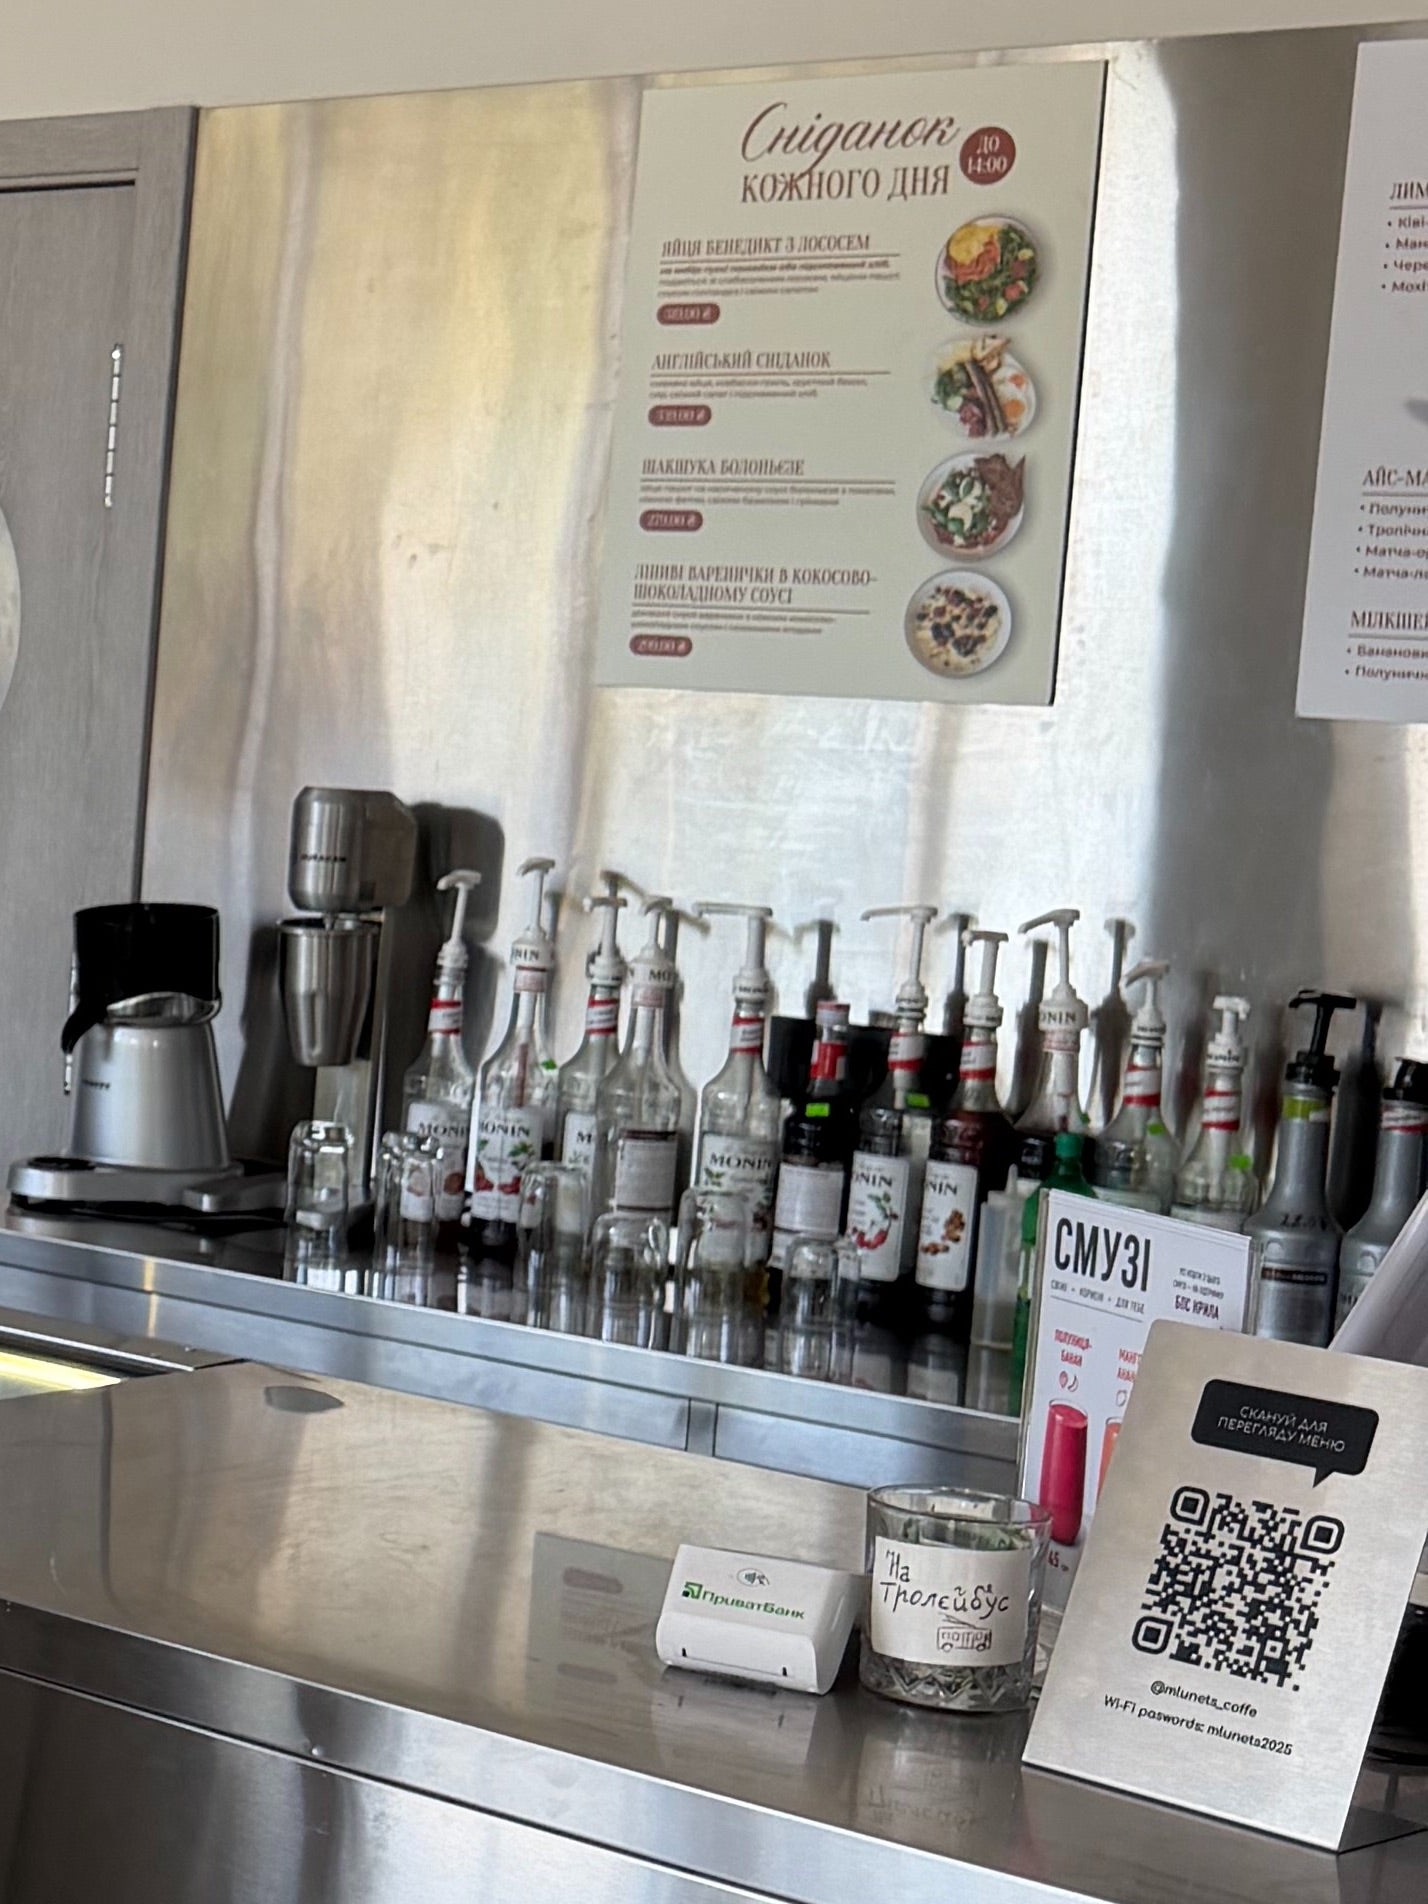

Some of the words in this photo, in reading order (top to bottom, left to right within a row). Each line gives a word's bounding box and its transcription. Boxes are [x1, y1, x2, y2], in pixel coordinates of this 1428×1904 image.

[741, 101, 960, 176] Сніданок
[976, 134, 1000, 154] ДО
[742, 167, 880, 203] КОЖНОГО
[888, 165, 950, 201] ДНЯ
[1390, 181, 1428, 200] ЛИМ
[756, 351, 832, 370] СНІДАНОК
[1351, 610, 1428, 631] МІЛКШЕ
[1040, 1011, 1076, 1024] ONIN
[418, 1121, 469, 1138] MONI
[926, 1180, 958, 1197] NIN
[1055, 1217, 1151, 1292] СМУЗІ
[1239, 1405, 1296, 1427] СКАНУЙ
[1298, 1417, 1328, 1434] ДЛЯ
[1217, 1416, 1296, 1442] ПЕРЕГЛЯДУ
[1298, 1433, 1346, 1453] МЕНЮ
[701, 1589, 805, 1620] ПриватБанк
[1150, 1680, 1258, 1718] @mlunets_coffe
[1104, 1694, 1136, 1714] Wi-Fi
[1137, 1707, 1204, 1733] paswords:
[1206, 1722, 1293, 1756] mlunets2025
